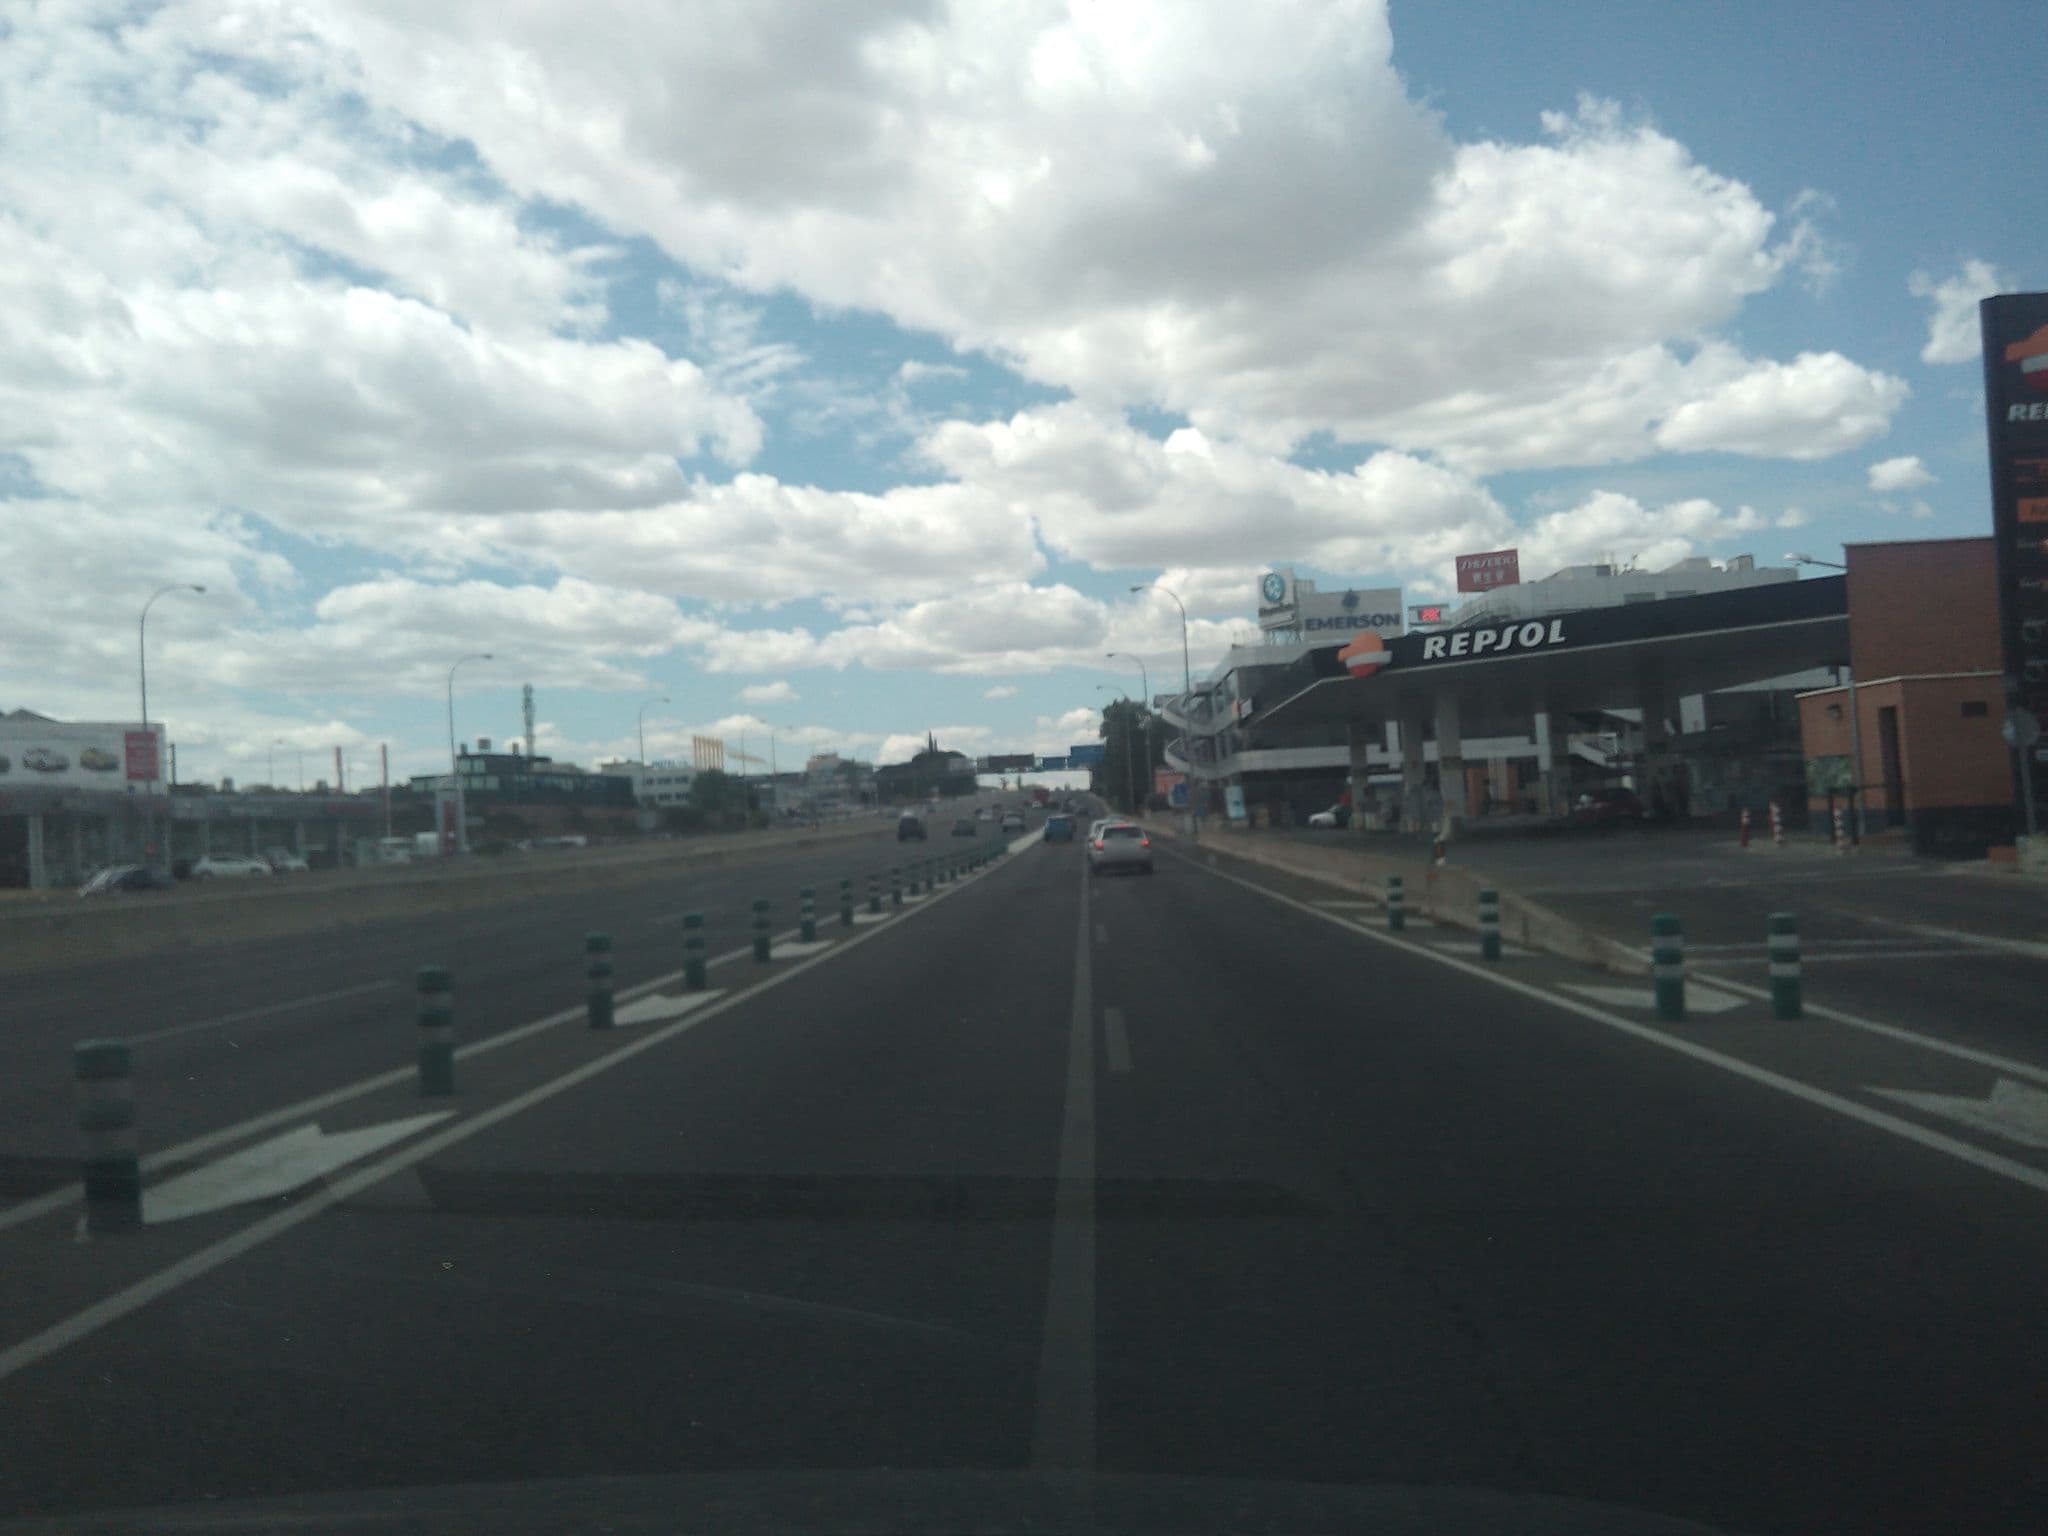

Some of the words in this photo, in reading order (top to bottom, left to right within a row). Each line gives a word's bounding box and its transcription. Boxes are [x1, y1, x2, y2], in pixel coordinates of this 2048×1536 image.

[2007, 402, 2048, 421] RE
[1304, 613, 1400, 631] EMERSON
[1423, 619, 1566, 660] REPSOL
